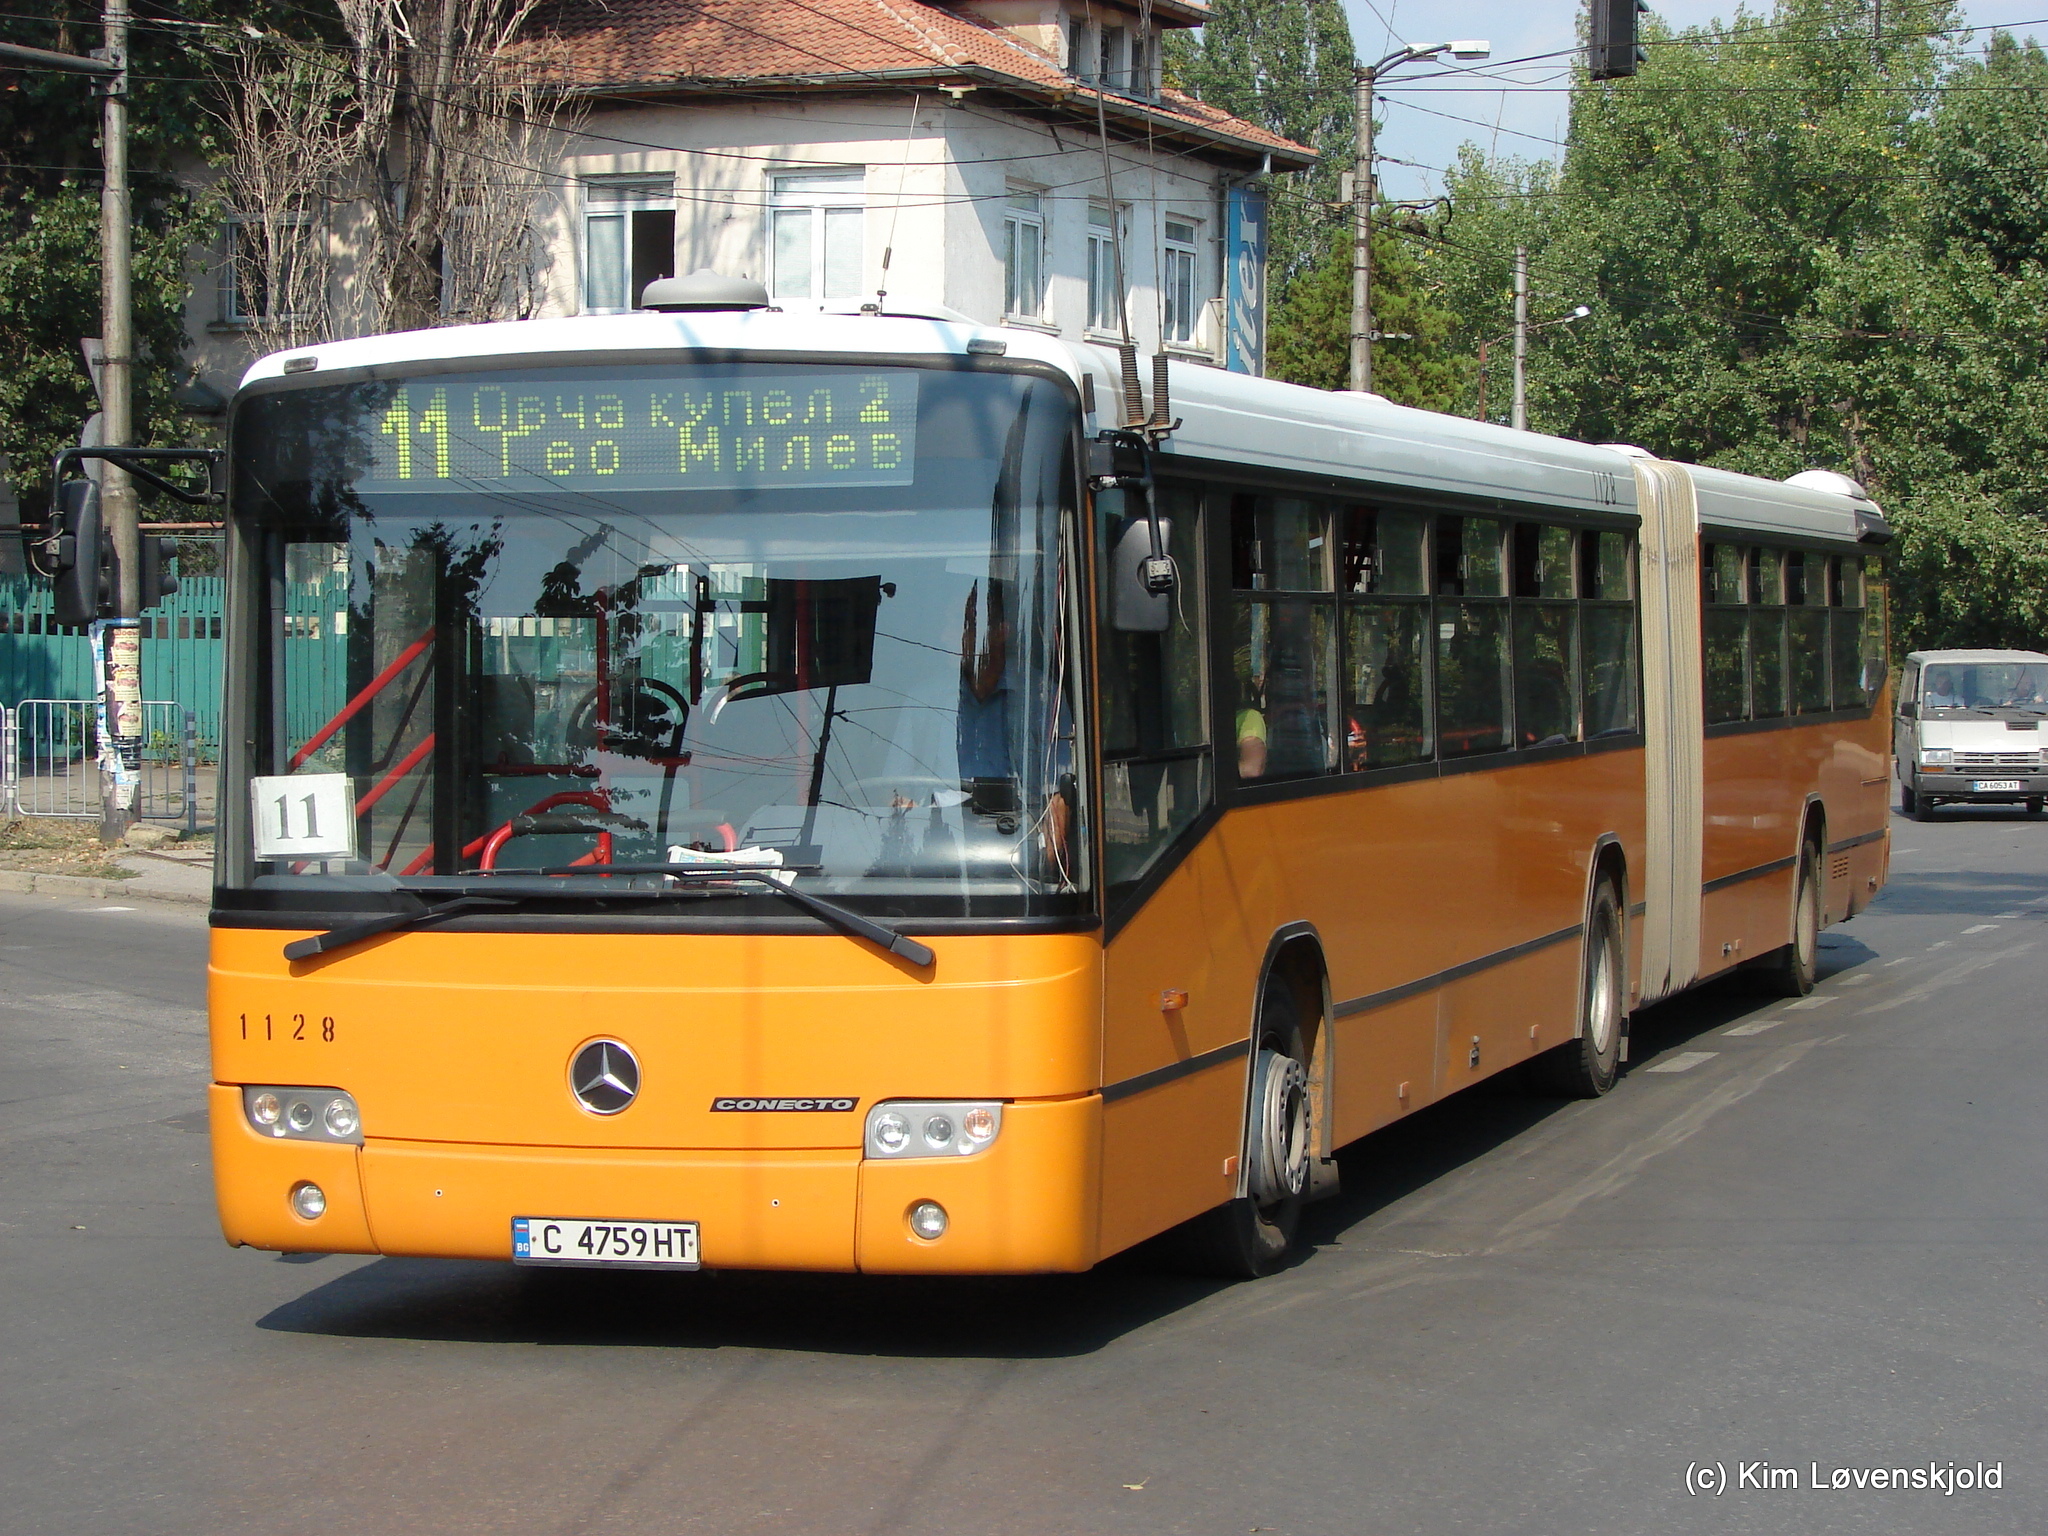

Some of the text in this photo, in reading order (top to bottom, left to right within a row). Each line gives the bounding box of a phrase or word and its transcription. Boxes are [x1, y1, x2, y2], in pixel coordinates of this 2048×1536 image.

[473, 376, 890, 432] Овча купел 2
[381, 387, 450, 480] 11
[501, 425, 902, 477] Гео Милев
[1592, 470, 1617, 505] 1128
[274, 793, 324, 840] 11
[240, 1013, 335, 1042] 1128
[716, 1099, 853, 1110] CONECTO
[516, 1243, 529, 1252] BG
